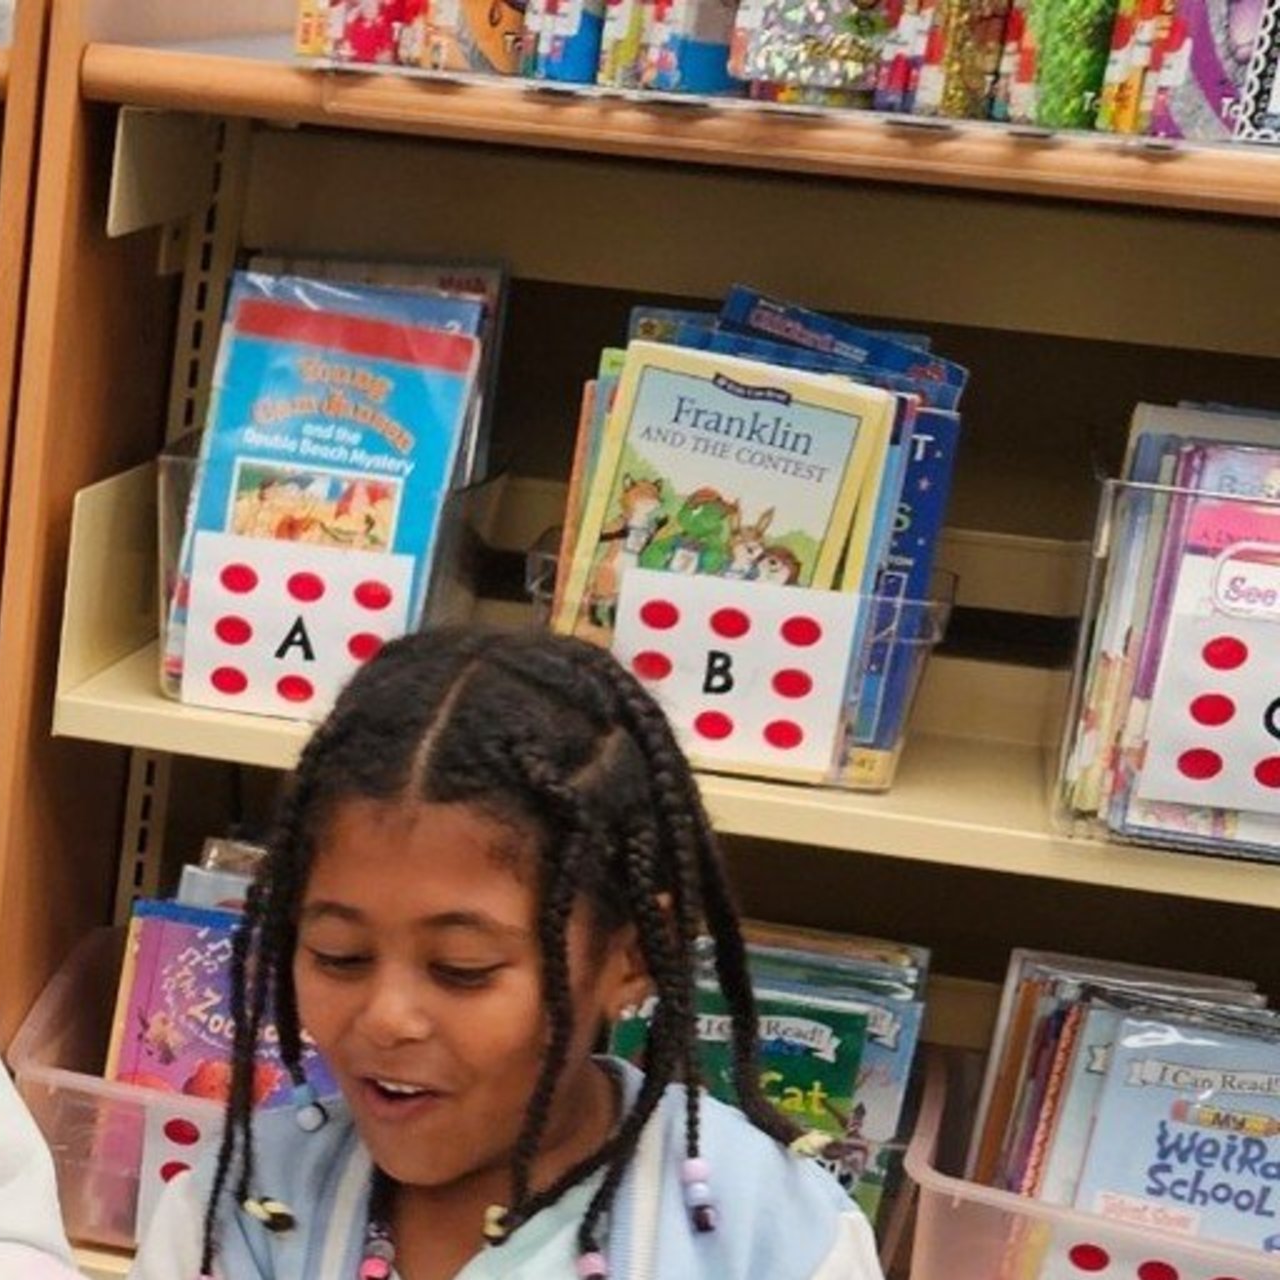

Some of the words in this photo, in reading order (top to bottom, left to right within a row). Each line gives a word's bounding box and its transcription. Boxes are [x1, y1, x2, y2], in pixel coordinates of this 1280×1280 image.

[335, 425, 363, 446] the
[671, 396, 812, 456] Franklin
[299, 438, 349, 461] Beach
[349, 448, 416, 478] Mystery
[640, 426, 686, 455] AND
[691, 433, 730, 458] THE
[735, 444, 831, 484] CONTEST
[275, 615, 316, 662] A
[702, 650, 735, 696] B
[758, 1069, 828, 1115] Cat
[1159, 1066, 1169, 1082] I
[1172, 1069, 1214, 1089] Can
[1211, 1112, 1247, 1130] MY
